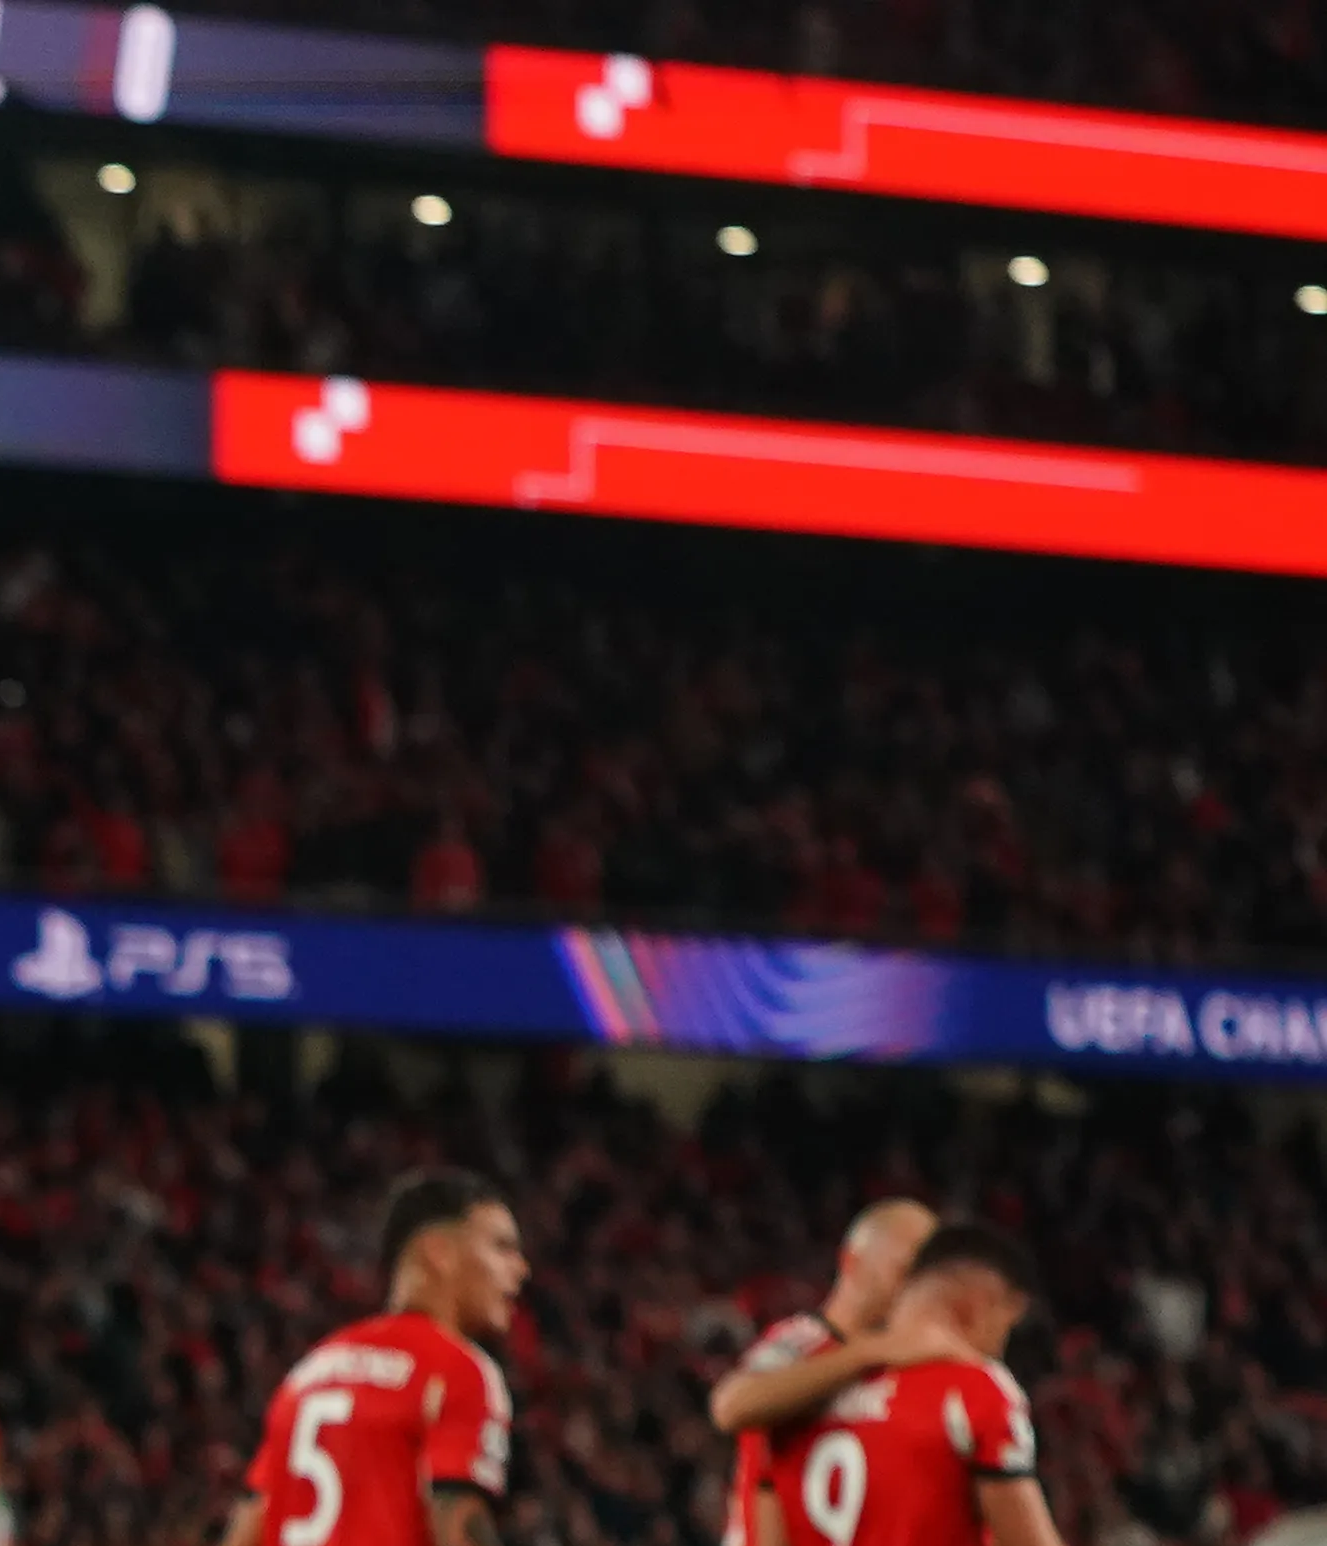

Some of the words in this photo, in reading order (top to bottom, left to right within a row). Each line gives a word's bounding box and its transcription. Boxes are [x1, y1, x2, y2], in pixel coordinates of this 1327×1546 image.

[107, 924, 294, 1000] PS5
[1044, 980, 1197, 1058] UEFA
[1197, 988, 1327, 1064] CHA
